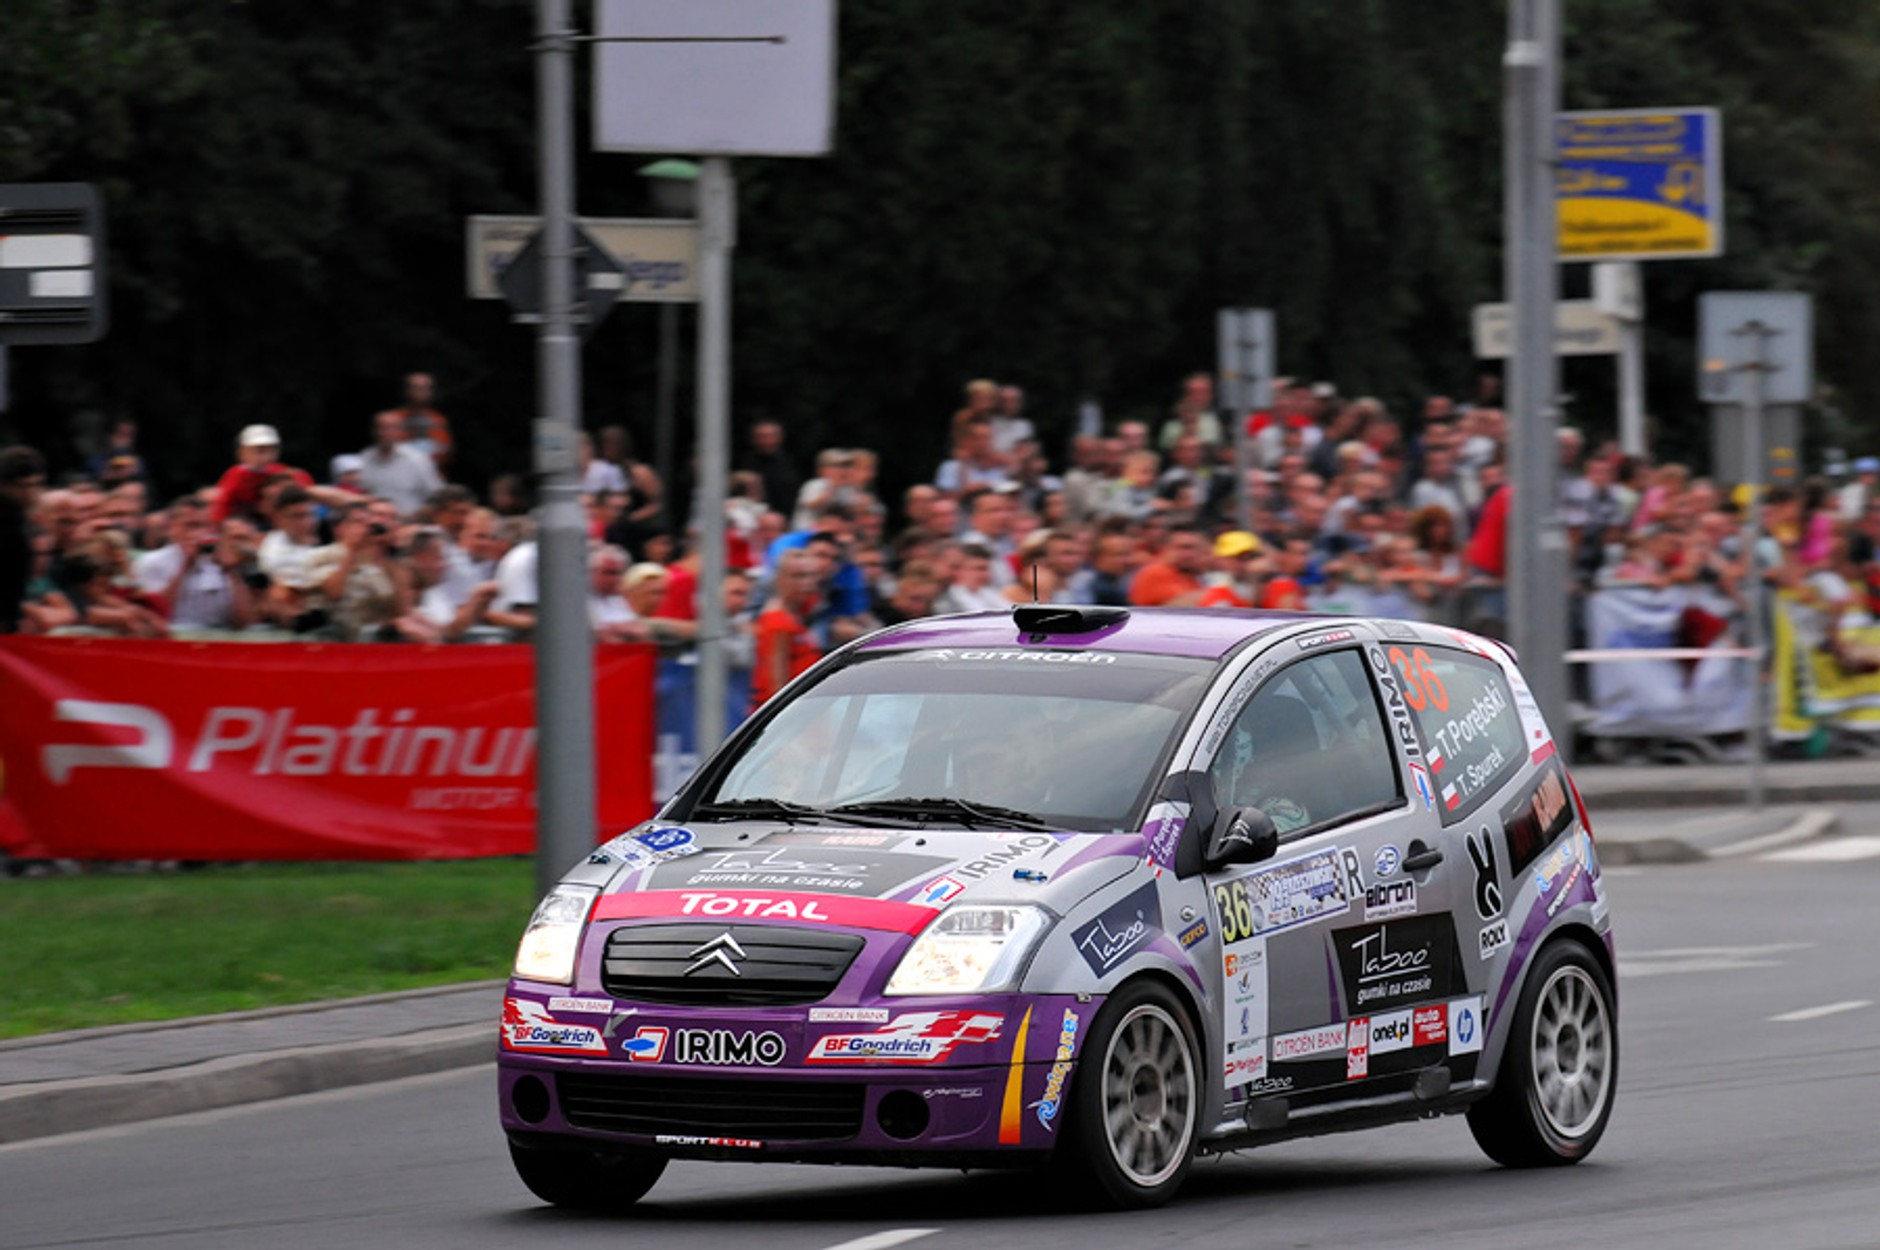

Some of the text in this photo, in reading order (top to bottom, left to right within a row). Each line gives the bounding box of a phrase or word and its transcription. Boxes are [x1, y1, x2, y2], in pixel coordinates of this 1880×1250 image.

[1388, 646, 1449, 712] 36
[1370, 647, 1420, 757] IRIMO
[1466, 744, 1505, 788] Spurek
[410, 787, 521, 809] MOTOR
[957, 835, 1052, 879] IRIMO
[687, 872, 864, 888] gumki na czasie
[1341, 850, 1365, 897] R
[681, 893, 828, 921] TOTAL
[1216, 881, 1252, 942] 36
[1080, 917, 1144, 962] Taboo
[1352, 925, 1428, 975] Taboo
[1481, 924, 1506, 949] ROLY
[1357, 975, 1432, 1005] gumki na czasie
[1373, 1017, 1410, 1042] onet.pl
[1414, 1009, 1440, 1023] auto
[514, 1026, 595, 1043] BFGoodrich
[675, 1029, 786, 1065] IRIMO
[825, 1038, 932, 1052] BFGoodrich
[1318, 1030, 1344, 1049] BANK
